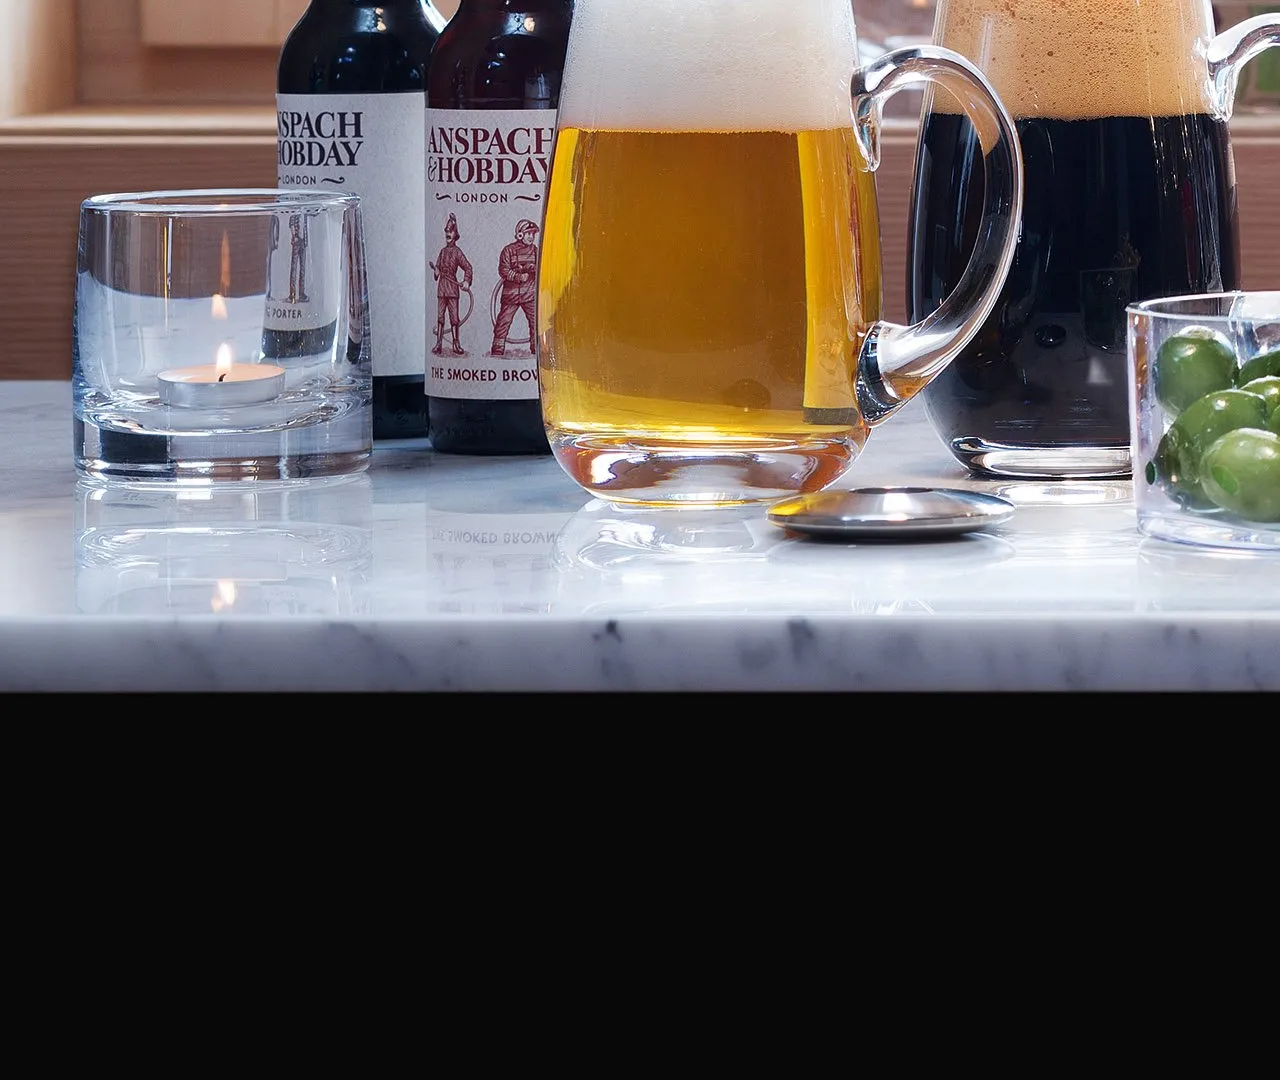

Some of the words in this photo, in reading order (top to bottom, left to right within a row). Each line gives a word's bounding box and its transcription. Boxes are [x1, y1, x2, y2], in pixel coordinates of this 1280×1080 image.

[428, 125, 554, 155] ANSPACH
[282, 175, 316, 185] LONDON
[455, 193, 508, 203] LONDON
[431, 367, 444, 379] THE
[447, 368, 497, 381] SMOKED
